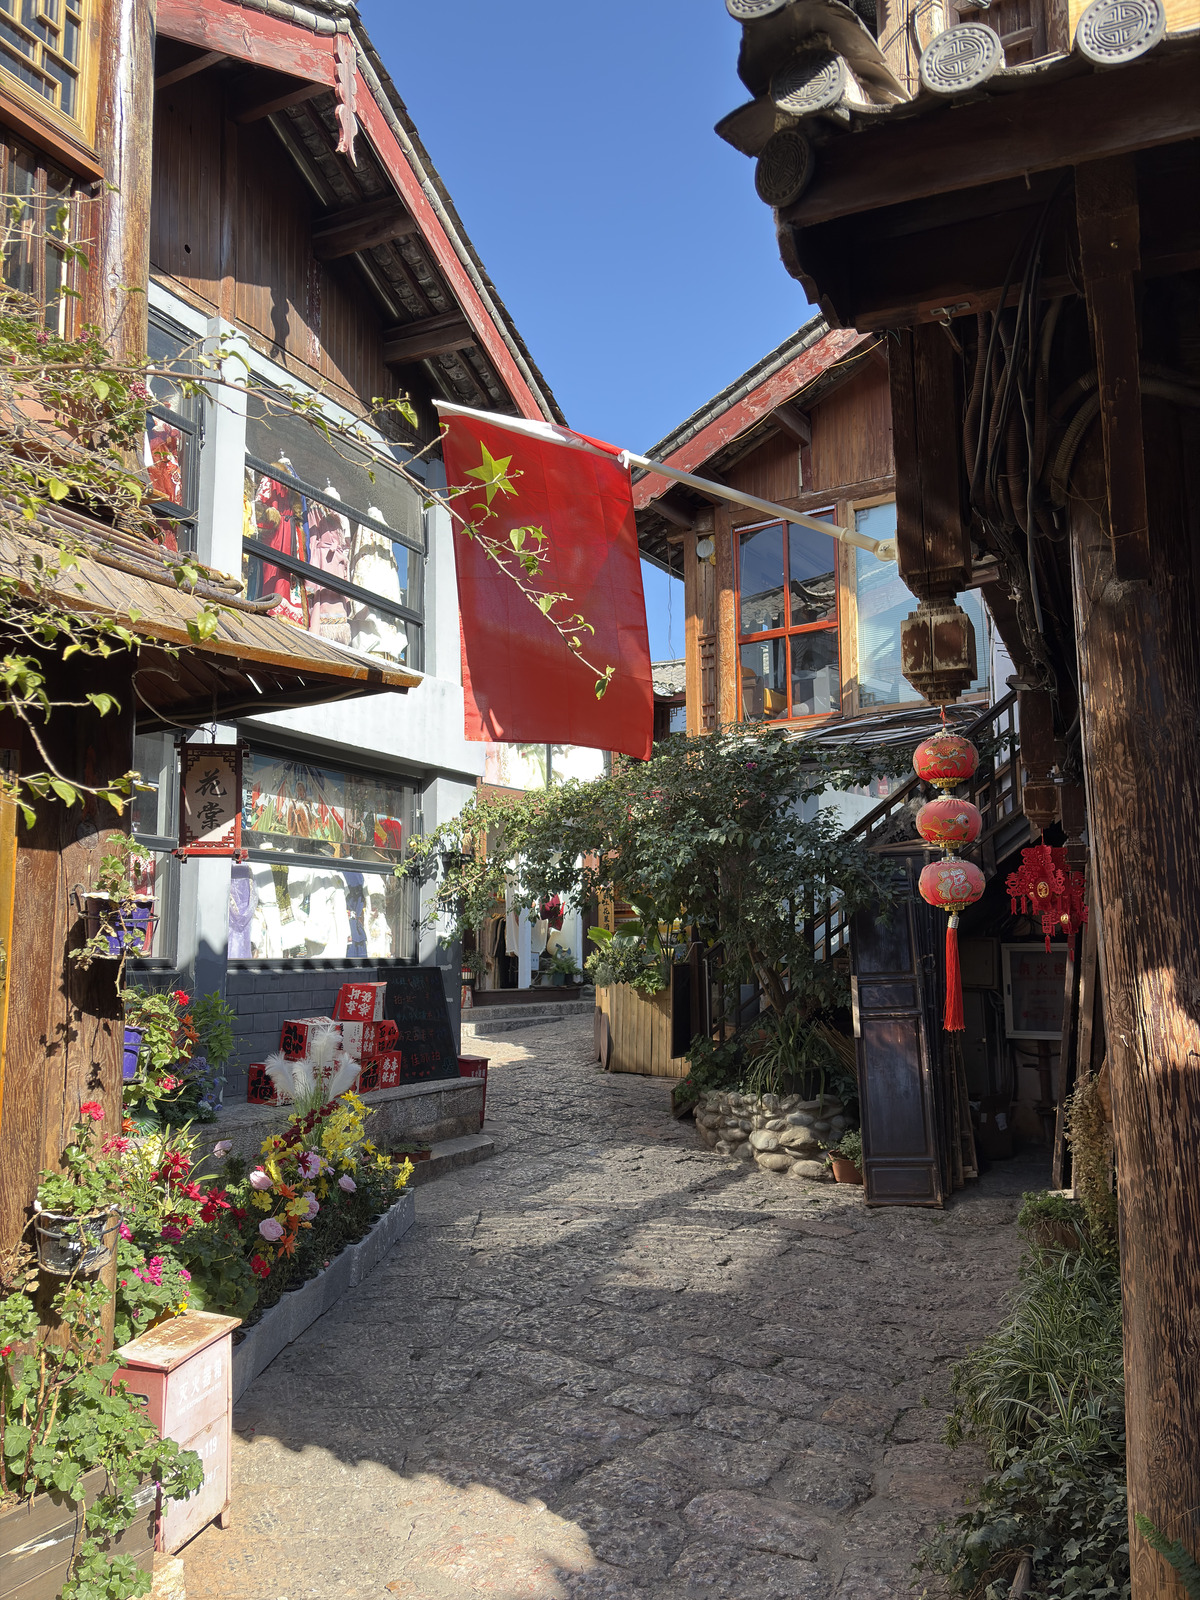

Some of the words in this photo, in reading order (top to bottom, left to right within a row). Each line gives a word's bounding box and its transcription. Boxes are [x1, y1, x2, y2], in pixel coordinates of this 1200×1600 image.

[194, 767, 228, 830] 花棠
[937, 868, 973, 900] 福
[204, 1435, 218, 1459] 119
